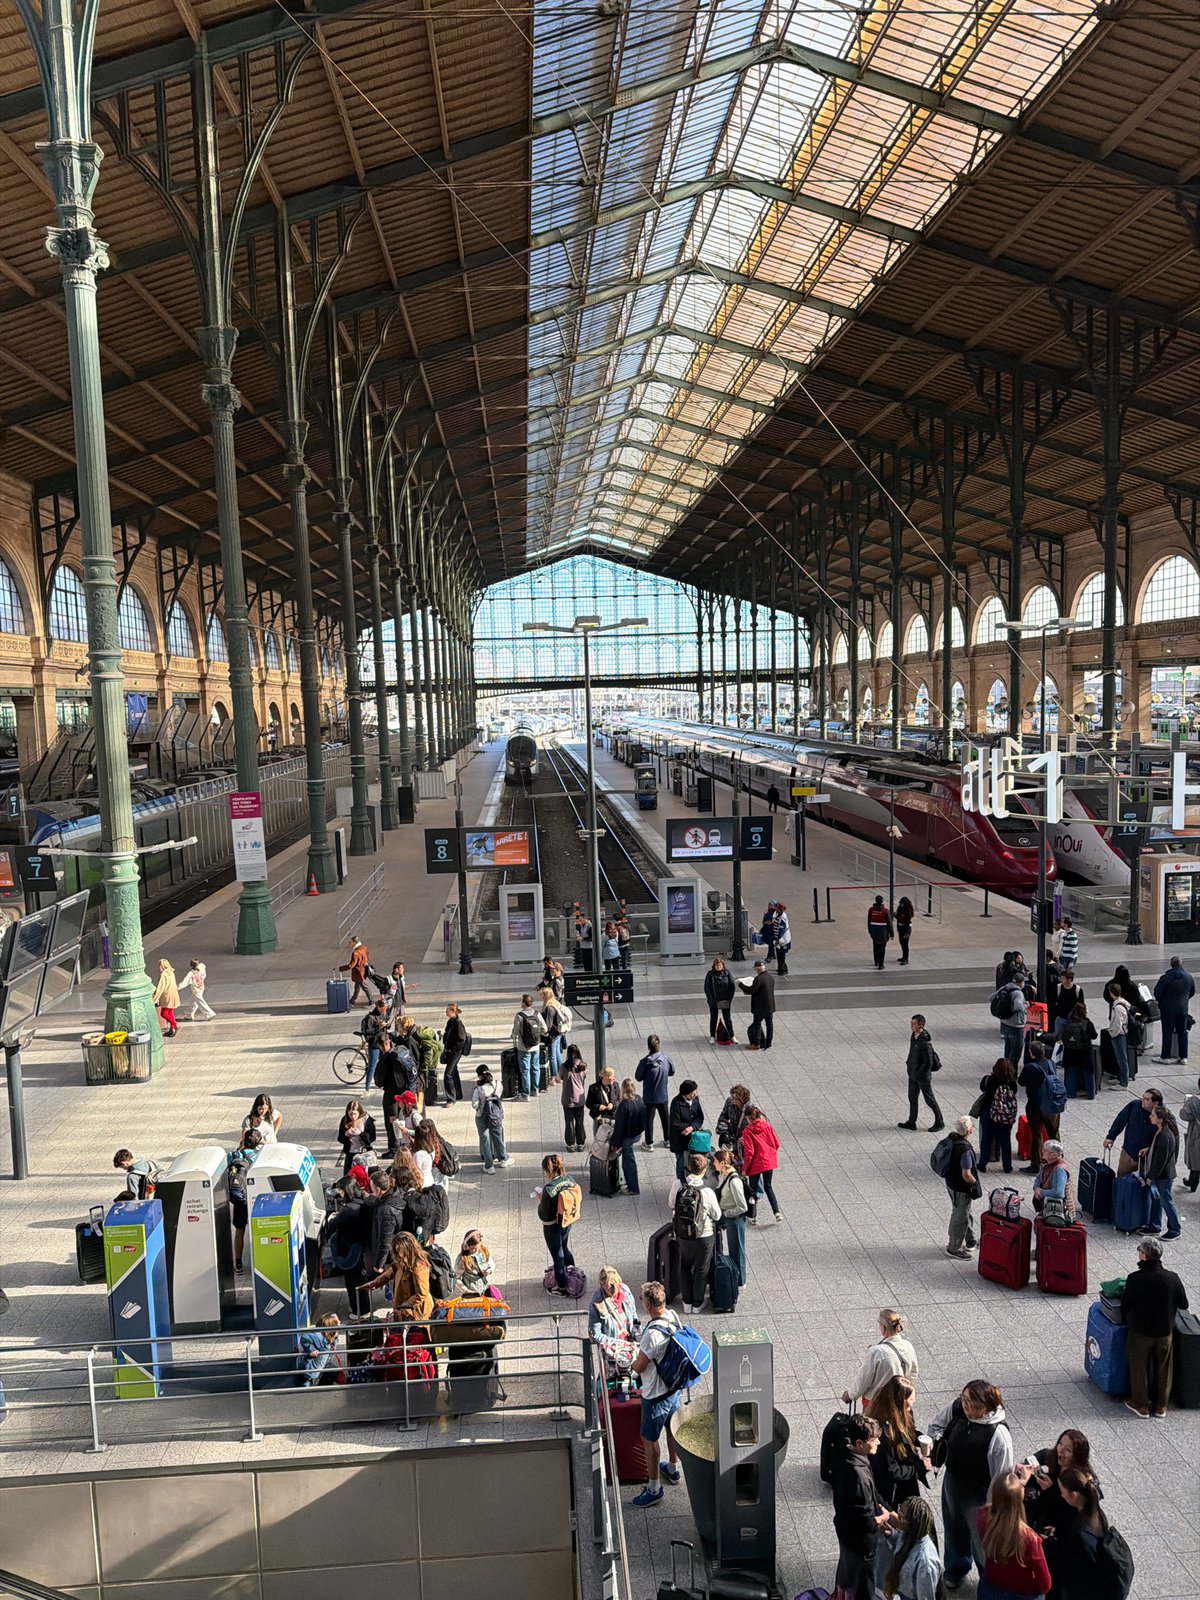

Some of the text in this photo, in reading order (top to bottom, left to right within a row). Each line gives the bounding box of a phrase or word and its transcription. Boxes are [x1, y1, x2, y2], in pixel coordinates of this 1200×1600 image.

[1027, 750, 1061, 824] 1
[11, 801, 17, 814] 7
[752, 833, 762, 847] 9
[437, 845, 447, 859] 8
[31, 863, 41, 877] 7
